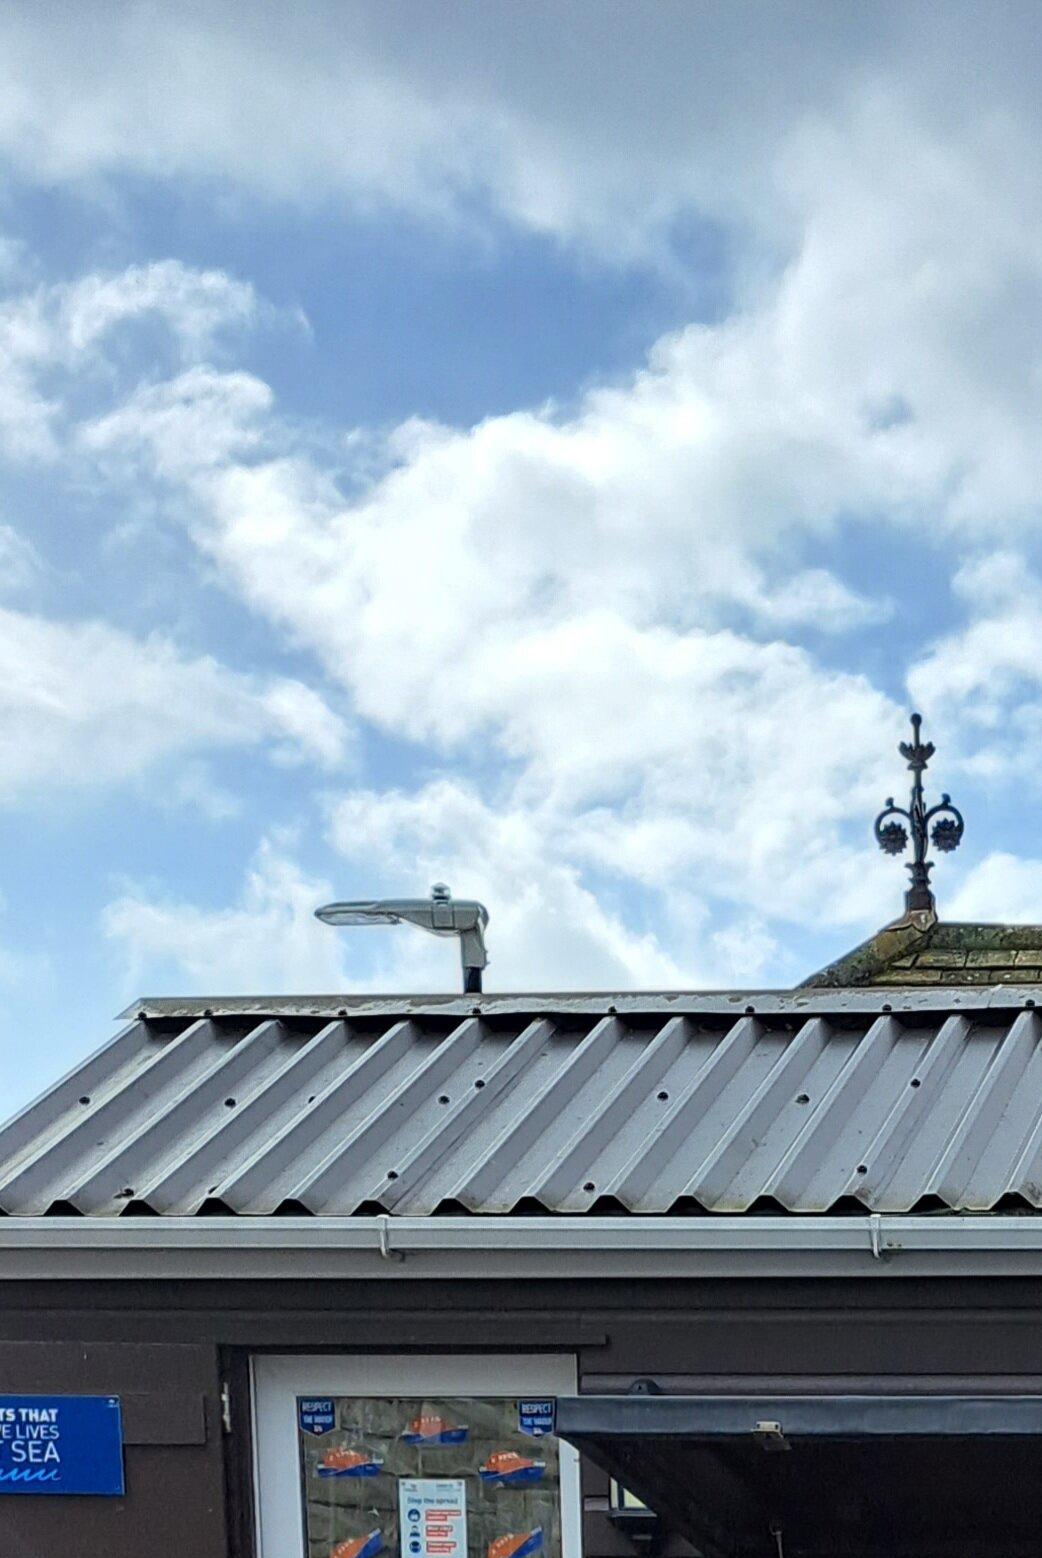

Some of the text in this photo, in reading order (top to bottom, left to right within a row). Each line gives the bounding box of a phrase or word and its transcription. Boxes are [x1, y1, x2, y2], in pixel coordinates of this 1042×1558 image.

[19, 1408, 58, 1422] THAT
[16, 1424, 60, 1439] LIVES
[11, 1441, 60, 1463] SEA
